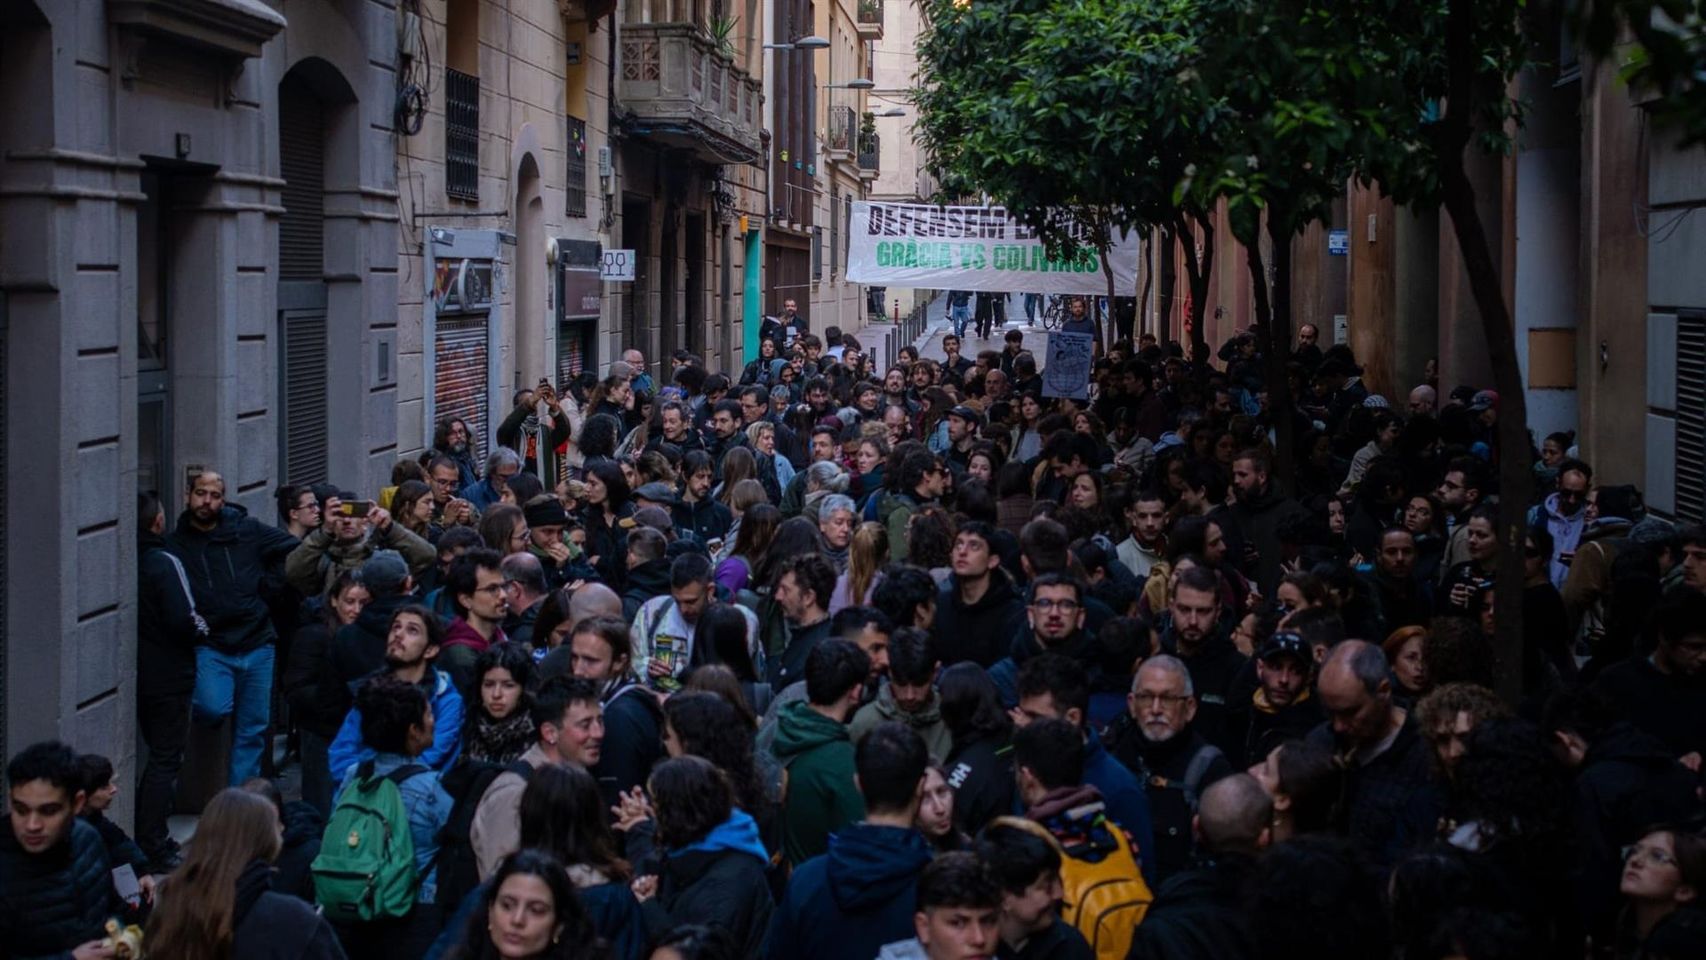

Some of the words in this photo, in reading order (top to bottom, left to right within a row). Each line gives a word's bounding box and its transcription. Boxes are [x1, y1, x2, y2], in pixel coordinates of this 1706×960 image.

[868, 205, 1005, 239] DEFENSEM
[876, 236, 952, 268] GRÀCIA
[960, 243, 986, 269] VS
[948, 762, 972, 789] HH
